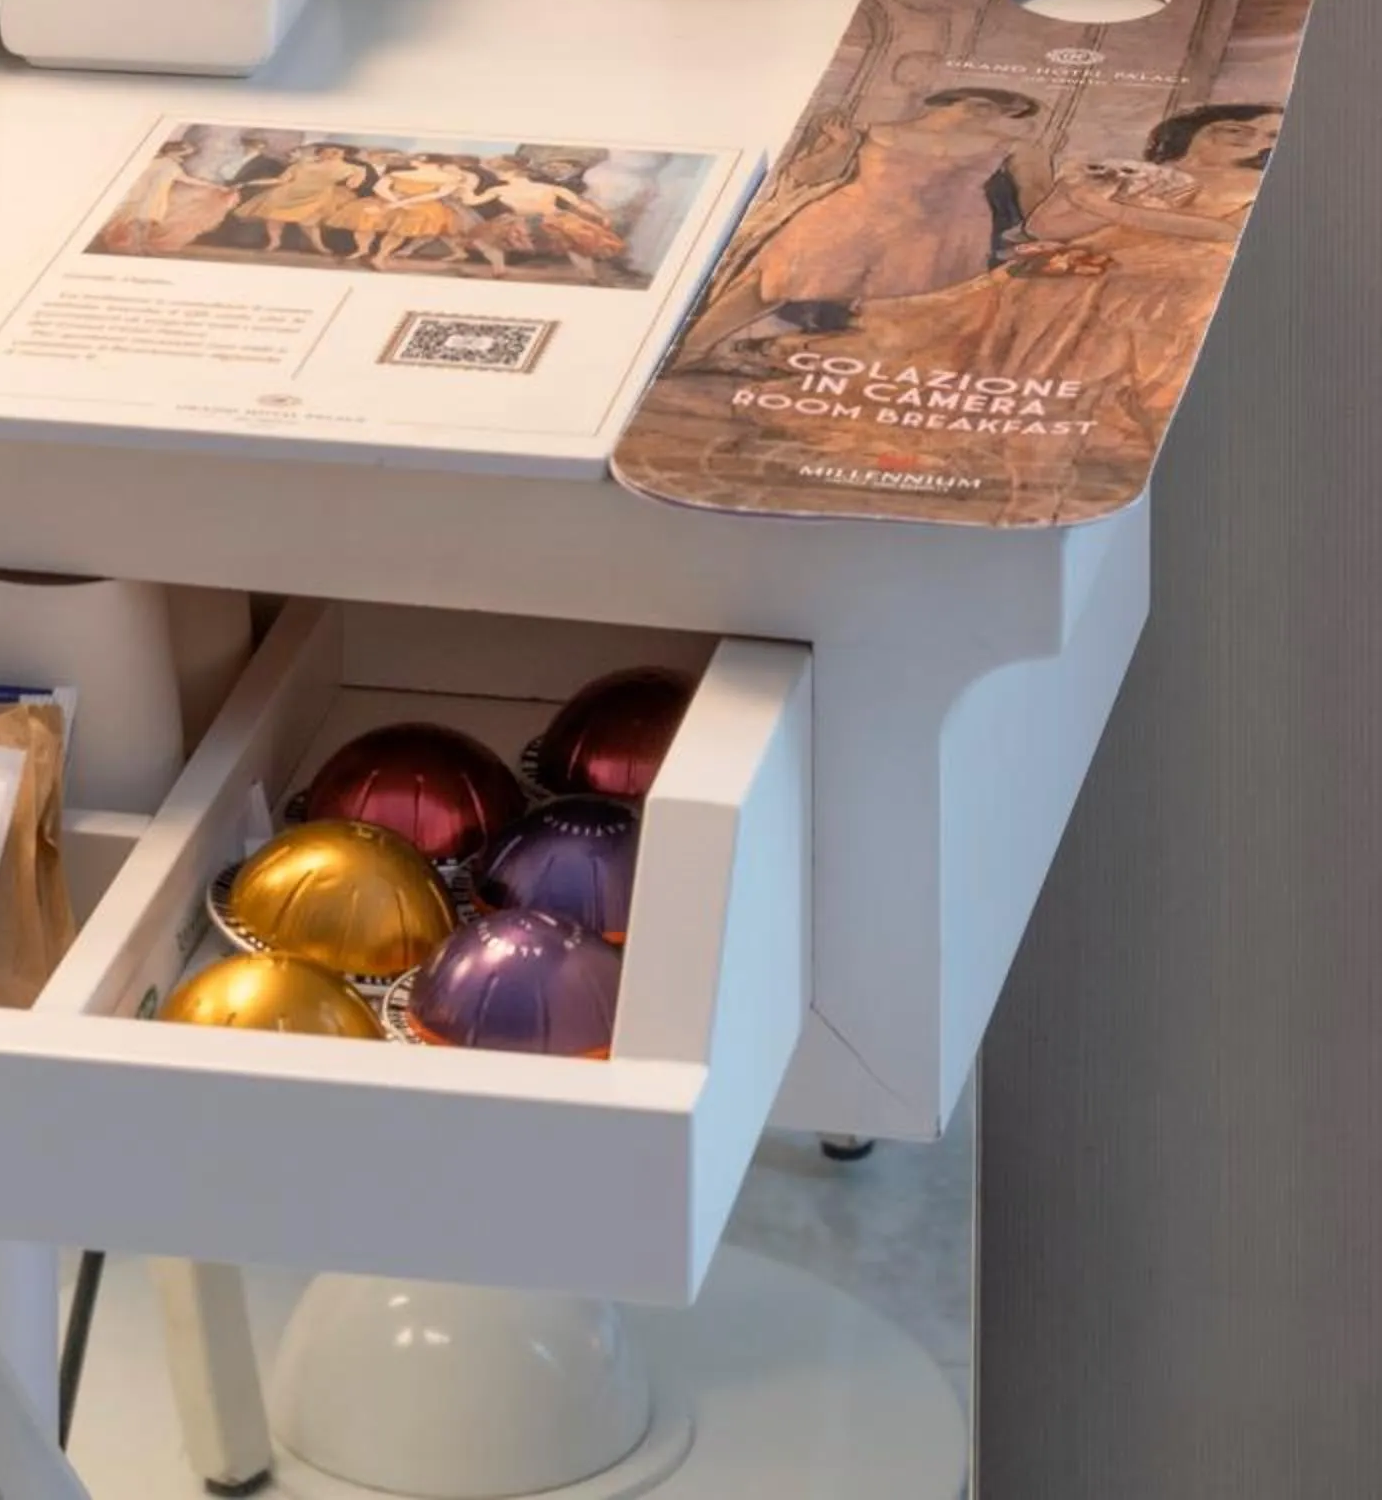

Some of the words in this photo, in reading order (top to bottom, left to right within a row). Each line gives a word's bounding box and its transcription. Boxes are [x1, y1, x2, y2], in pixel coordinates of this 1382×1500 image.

[788, 352, 1083, 399] COLAZIONE
[801, 373, 850, 397] IN
[863, 382, 1048, 417] CAMERA
[732, 388, 862, 420] ROOM
[876, 406, 1099, 437] BREAKFAST
[799, 464, 982, 490] MILLENNIUM
